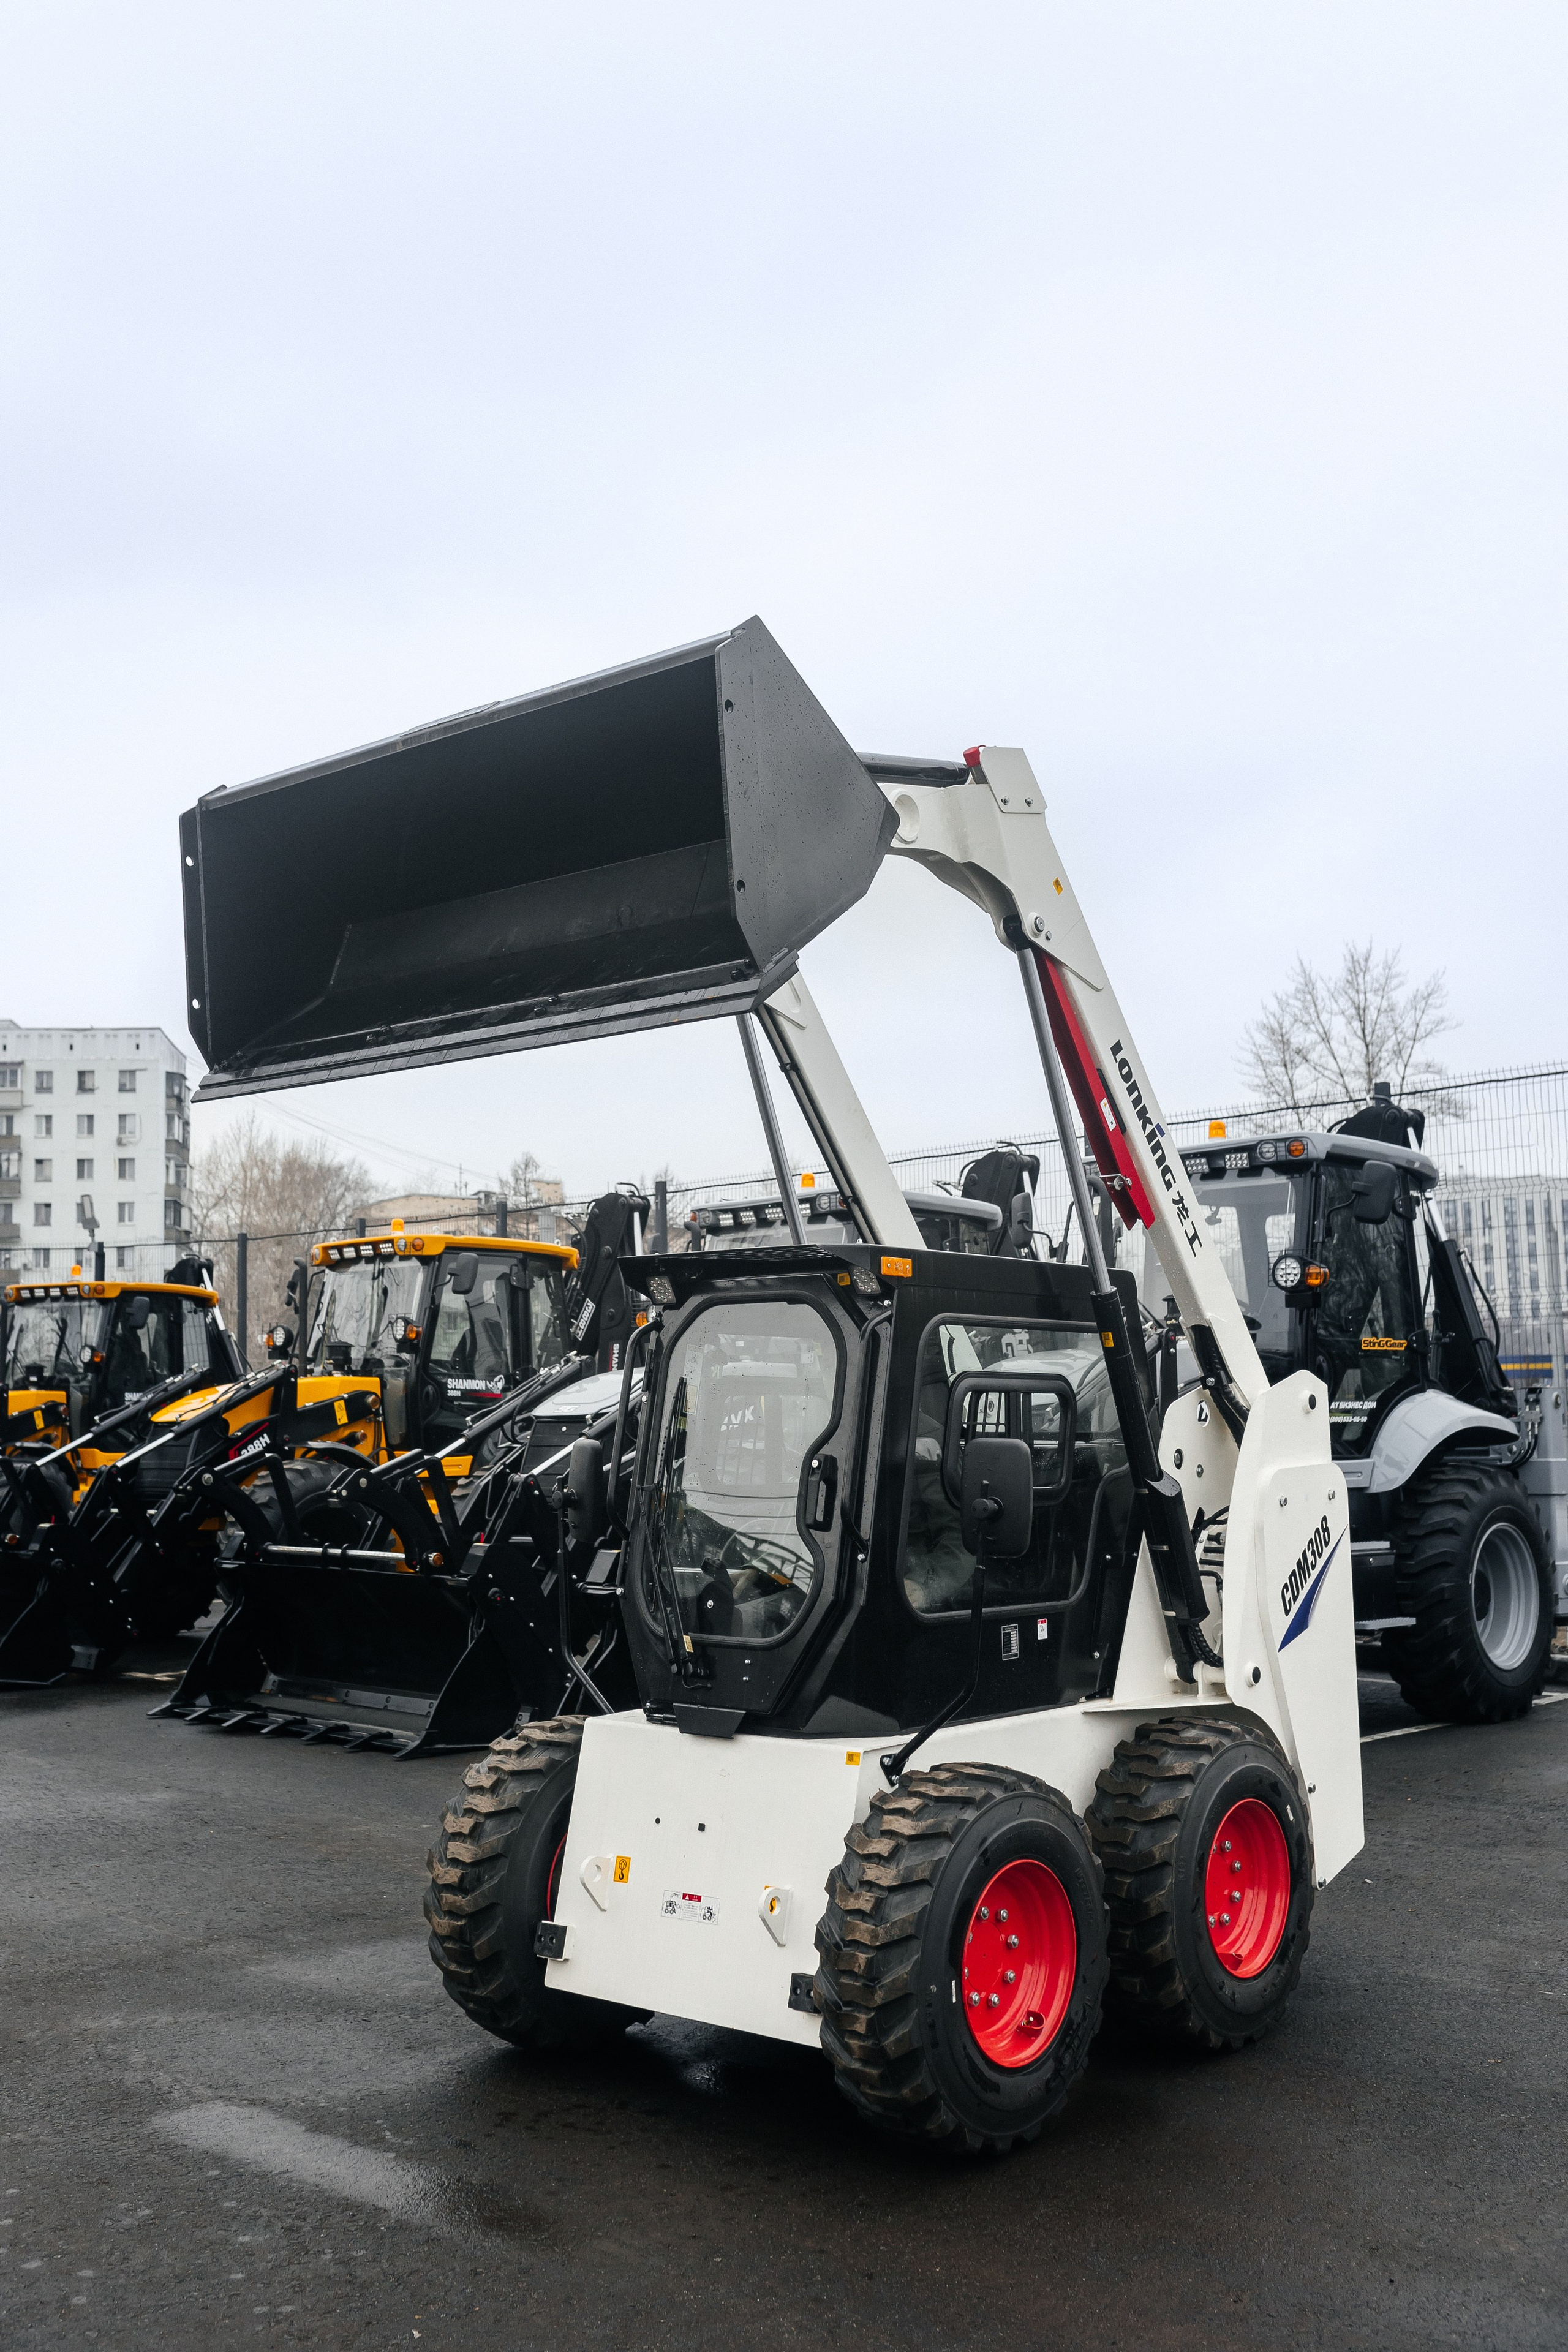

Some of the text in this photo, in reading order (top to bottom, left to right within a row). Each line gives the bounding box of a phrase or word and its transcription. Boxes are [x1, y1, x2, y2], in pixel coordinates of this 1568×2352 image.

[576, 1302, 593, 1337] 388H
[447, 1378, 486, 1390] SHANMON
[1363, 1401, 1376, 1410] ДОМ
[1281, 1515, 1330, 1616] CDM308
